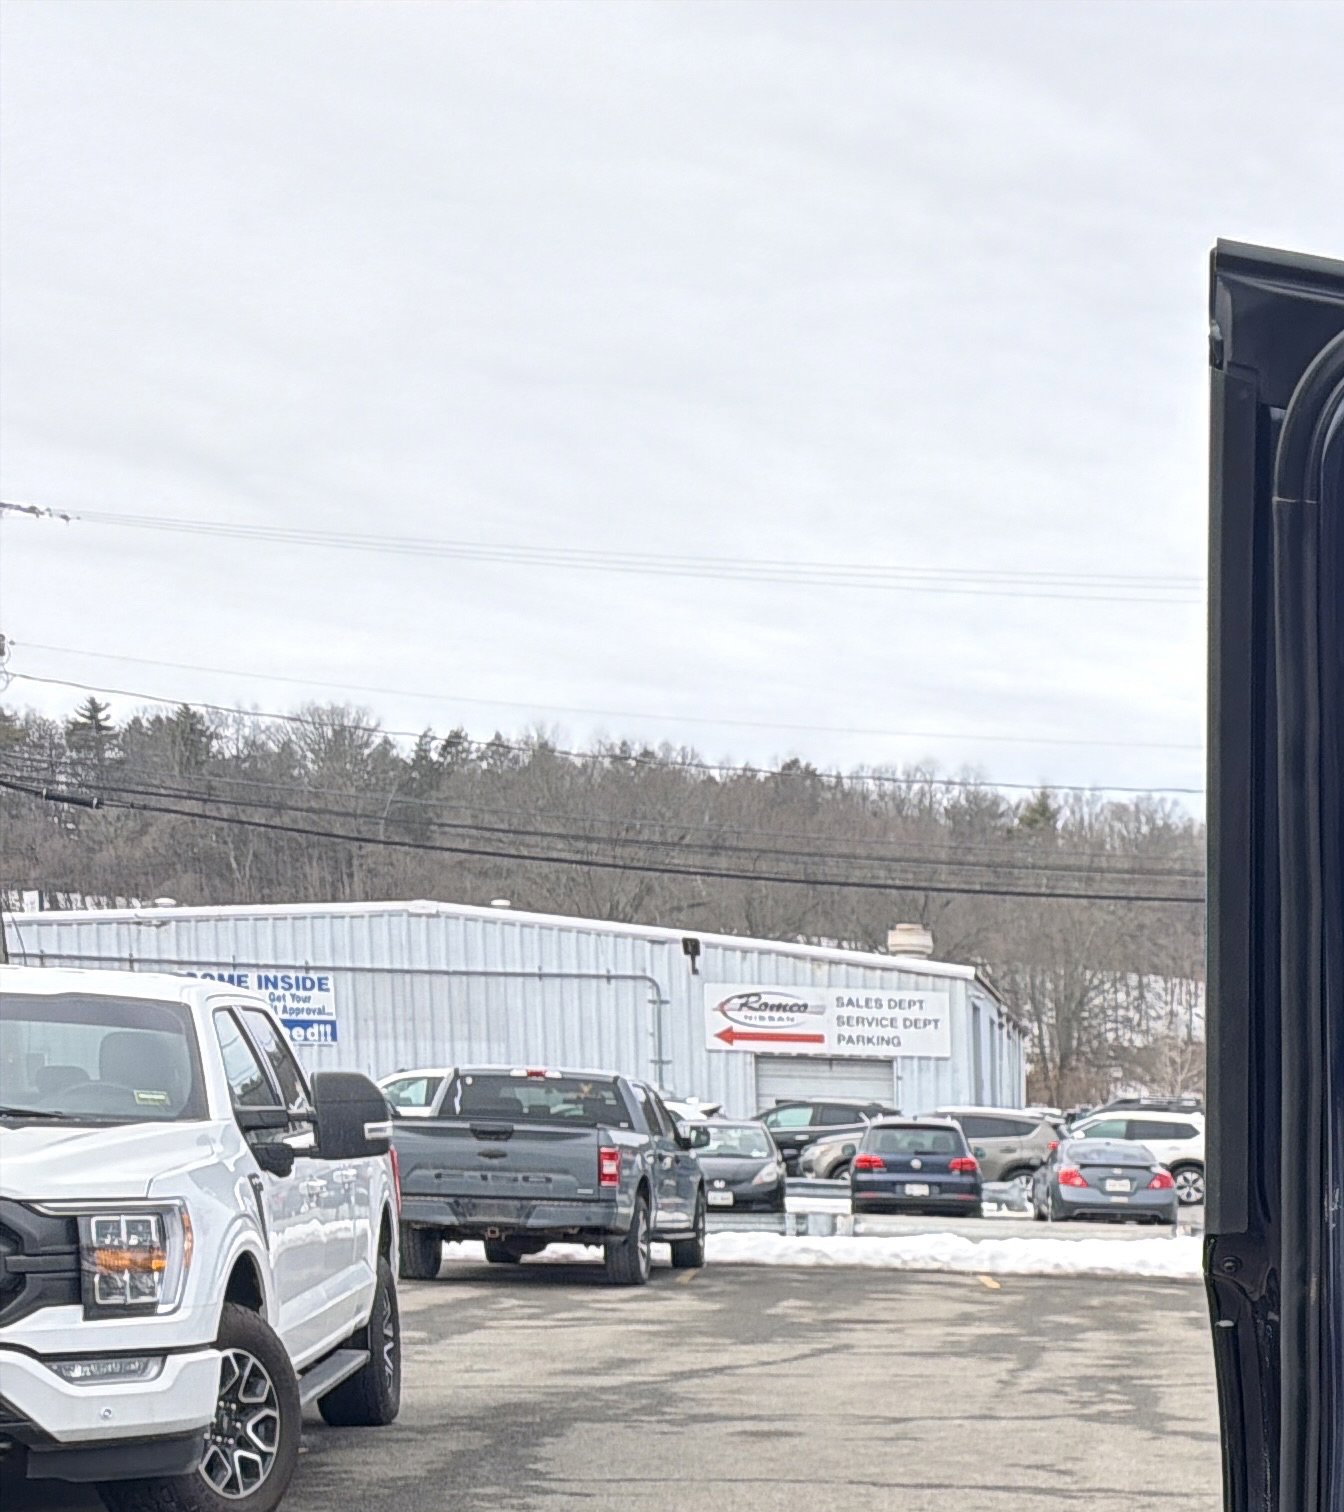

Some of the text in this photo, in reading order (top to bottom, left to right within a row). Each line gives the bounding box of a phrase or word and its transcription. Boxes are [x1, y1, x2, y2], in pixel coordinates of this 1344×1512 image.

[257, 974, 330, 992] INSIDE
[268, 992, 311, 1003] Get Your
[835, 996, 925, 1010] SALES DEPT
[836, 1015, 940, 1030] SERVICE DEPT
[837, 1033, 902, 1047] PARKING
